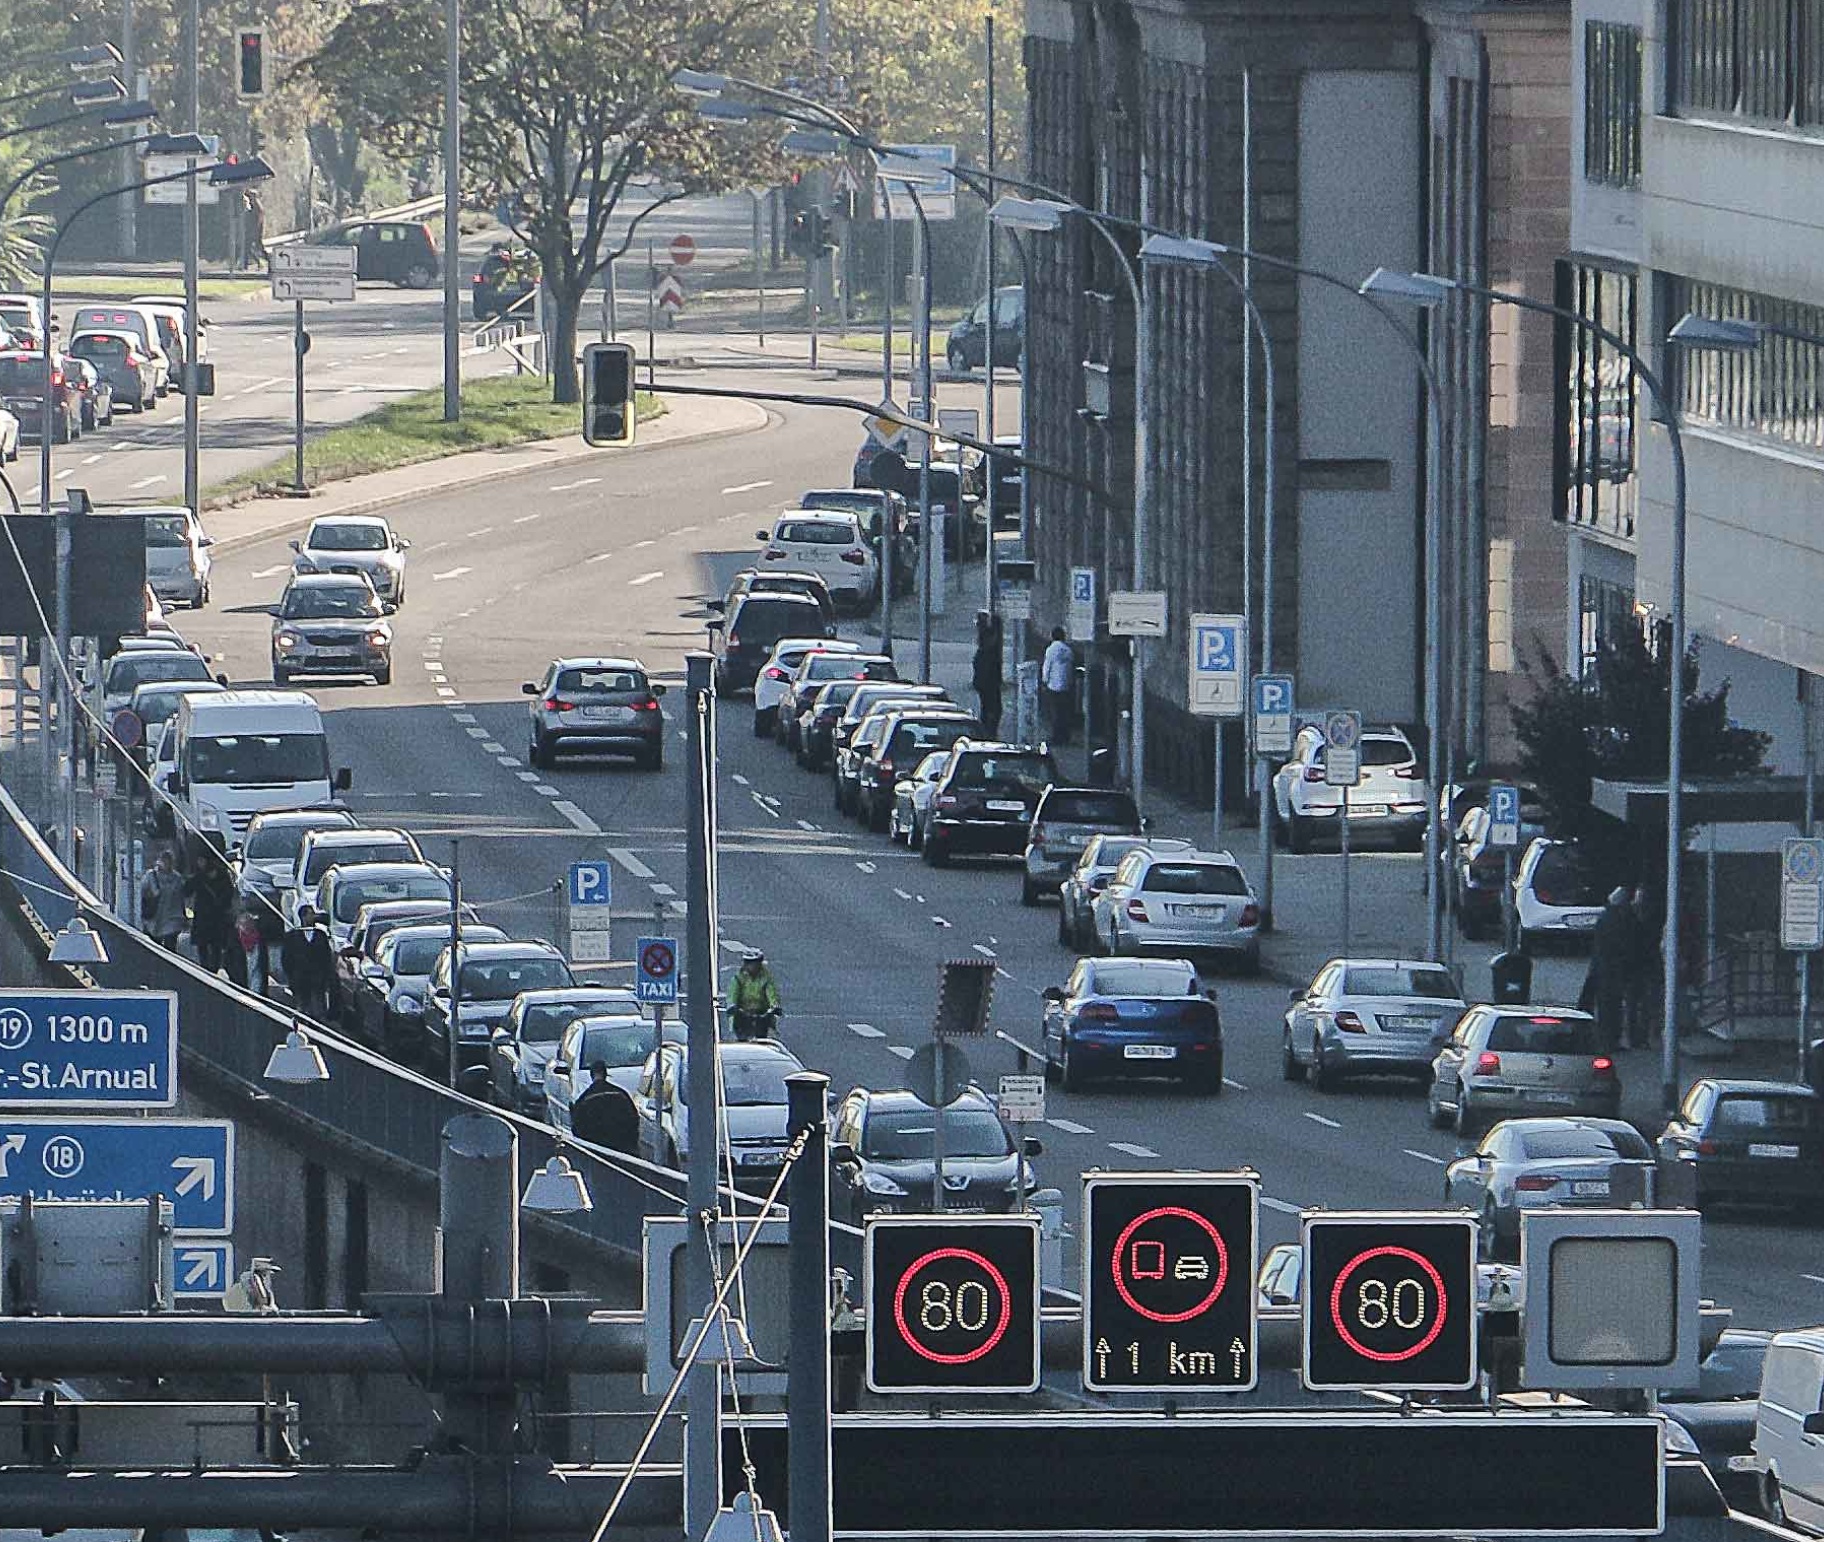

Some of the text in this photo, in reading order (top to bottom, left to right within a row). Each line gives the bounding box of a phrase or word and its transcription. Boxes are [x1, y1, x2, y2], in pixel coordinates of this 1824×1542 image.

[1202, 630, 1224, 666] P
[1262, 685, 1282, 711] P
[1496, 792, 1510, 821] P
[578, 867, 600, 900] P
[640, 982, 673, 997] TAXI
[0, 1016, 148, 1044] 19 1300 m
[51, 1147, 74, 1168] 18
[919, 1280, 988, 1331] 80
[1357, 1278, 1425, 1329] 80
[1127, 1341, 1217, 1375] 1 km
